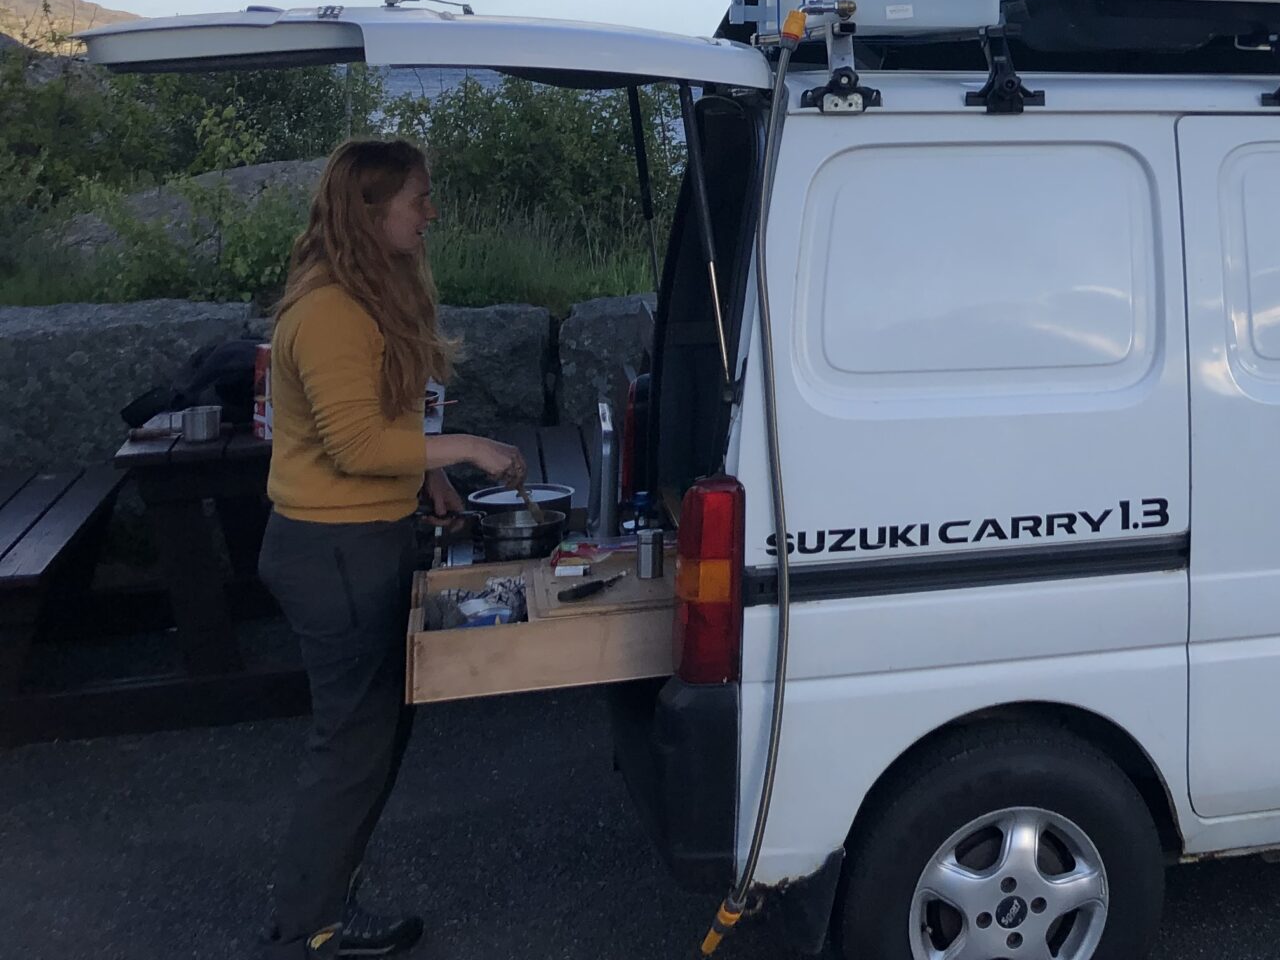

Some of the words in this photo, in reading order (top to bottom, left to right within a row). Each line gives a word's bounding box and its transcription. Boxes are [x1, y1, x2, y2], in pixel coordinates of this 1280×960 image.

[765, 523, 929, 556] SUZUKI
[938, 509, 1113, 544] CARRY
[1119, 497, 1169, 531] 1.3
